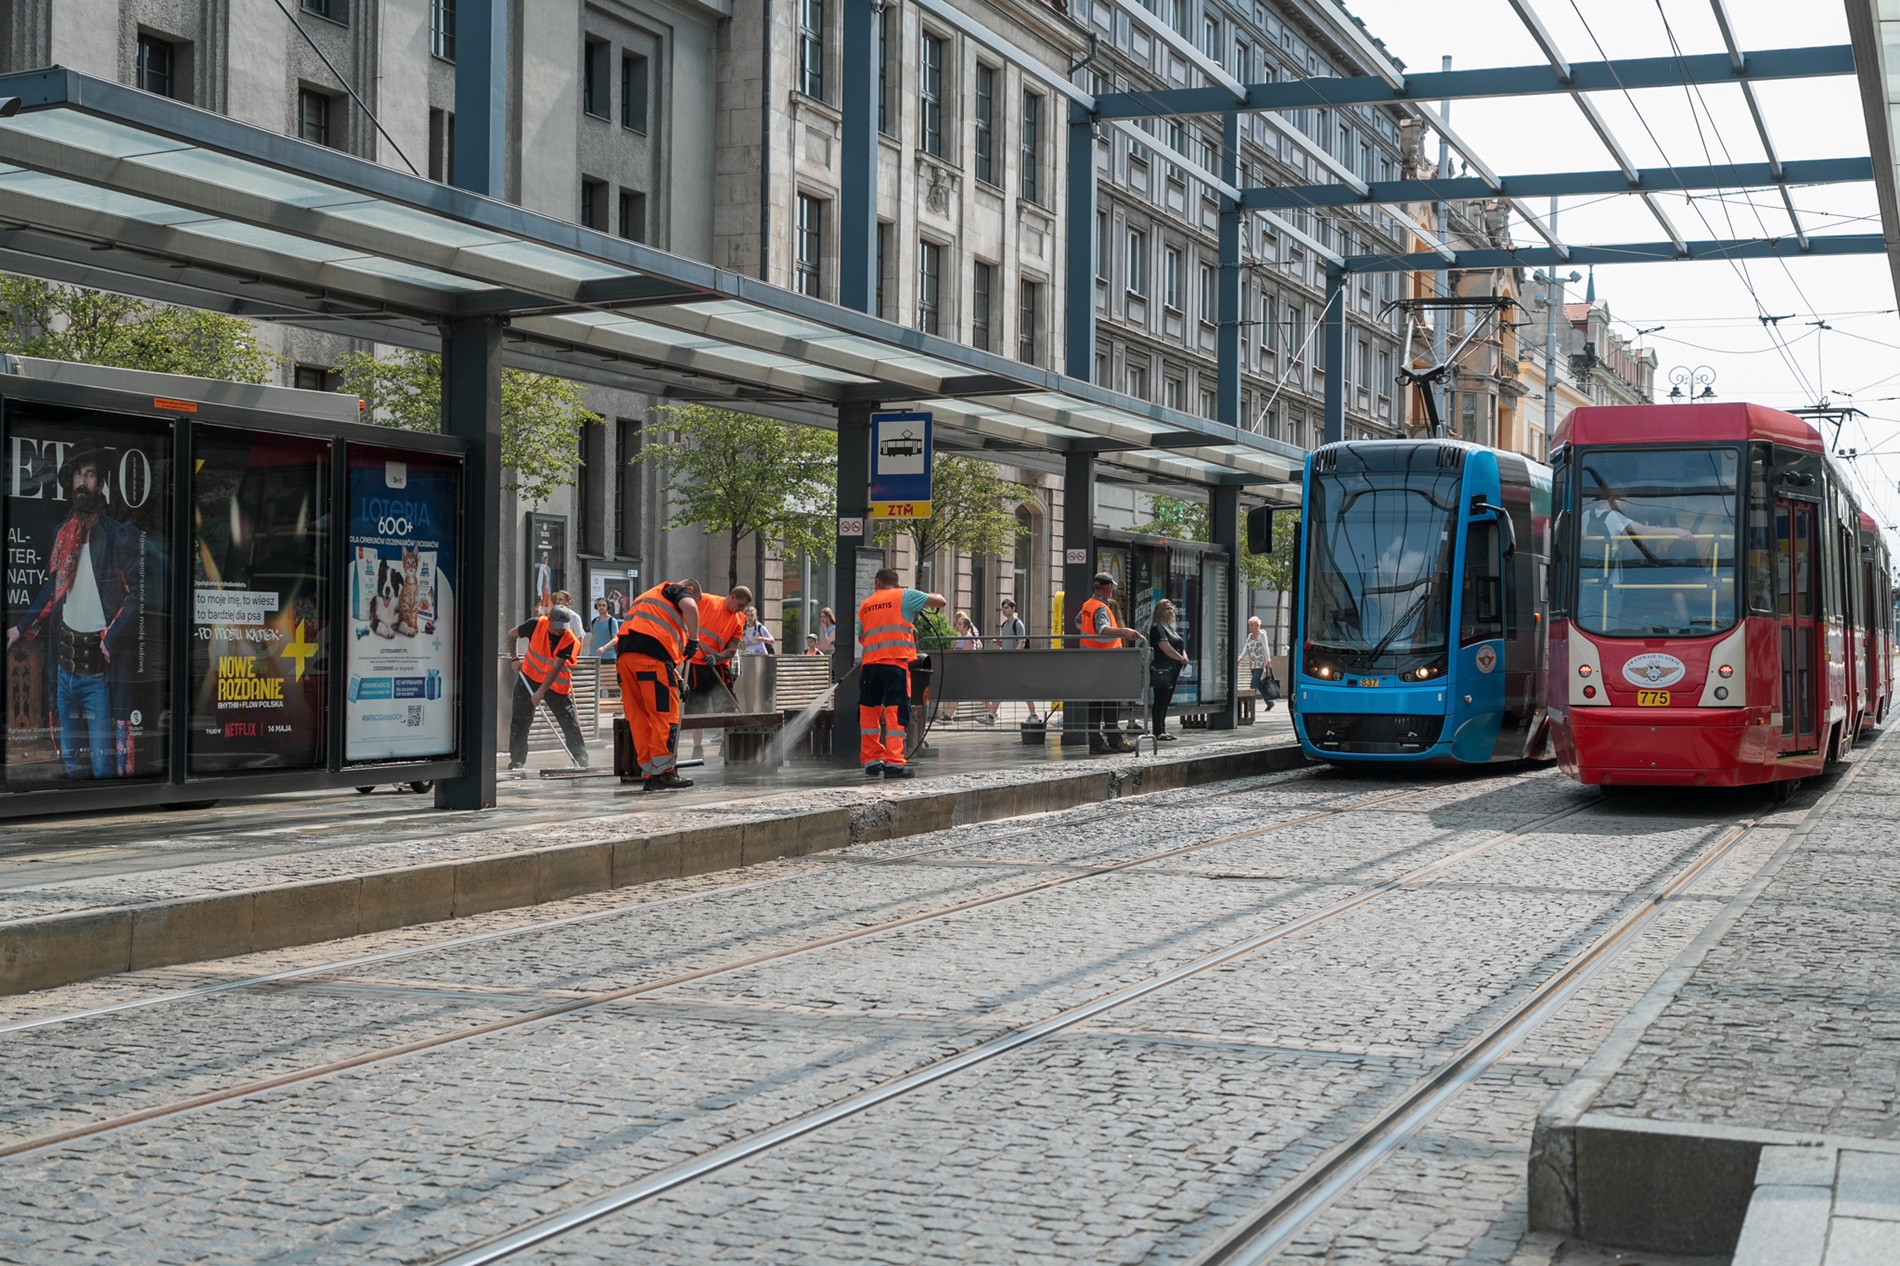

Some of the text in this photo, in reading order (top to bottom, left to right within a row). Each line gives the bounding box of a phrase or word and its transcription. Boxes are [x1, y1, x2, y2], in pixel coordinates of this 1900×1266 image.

[9, 436, 152, 509] ETO
[887, 503, 914, 516] ZTM
[378, 516, 413, 536] 600+
[7, 527, 31, 543] AL-
[139, 531, 147, 555] Nowe
[349, 535, 360, 543] DLA
[7, 549, 42, 565] TER-
[7, 569, 49, 585] NATY-
[138, 556, 146, 602] spojrzenie
[7, 589, 31, 605] WA
[197, 593, 275, 608] to moje imię, to wiesz
[139, 603, 145, 614] na
[197, 609, 261, 622] to bardziej dla psa
[218, 655, 257, 678] NOWE
[1626, 654, 1657, 667] TRAMWAJE
[217, 677, 285, 701] ROZDANIE
[1361, 678, 1377, 687] 837
[258, 700, 284, 709] POLSKA
[1640, 691, 1668, 705] 775
[224, 722, 257, 739] NETFLIX
[267, 724, 292, 733] 14 MAJA
